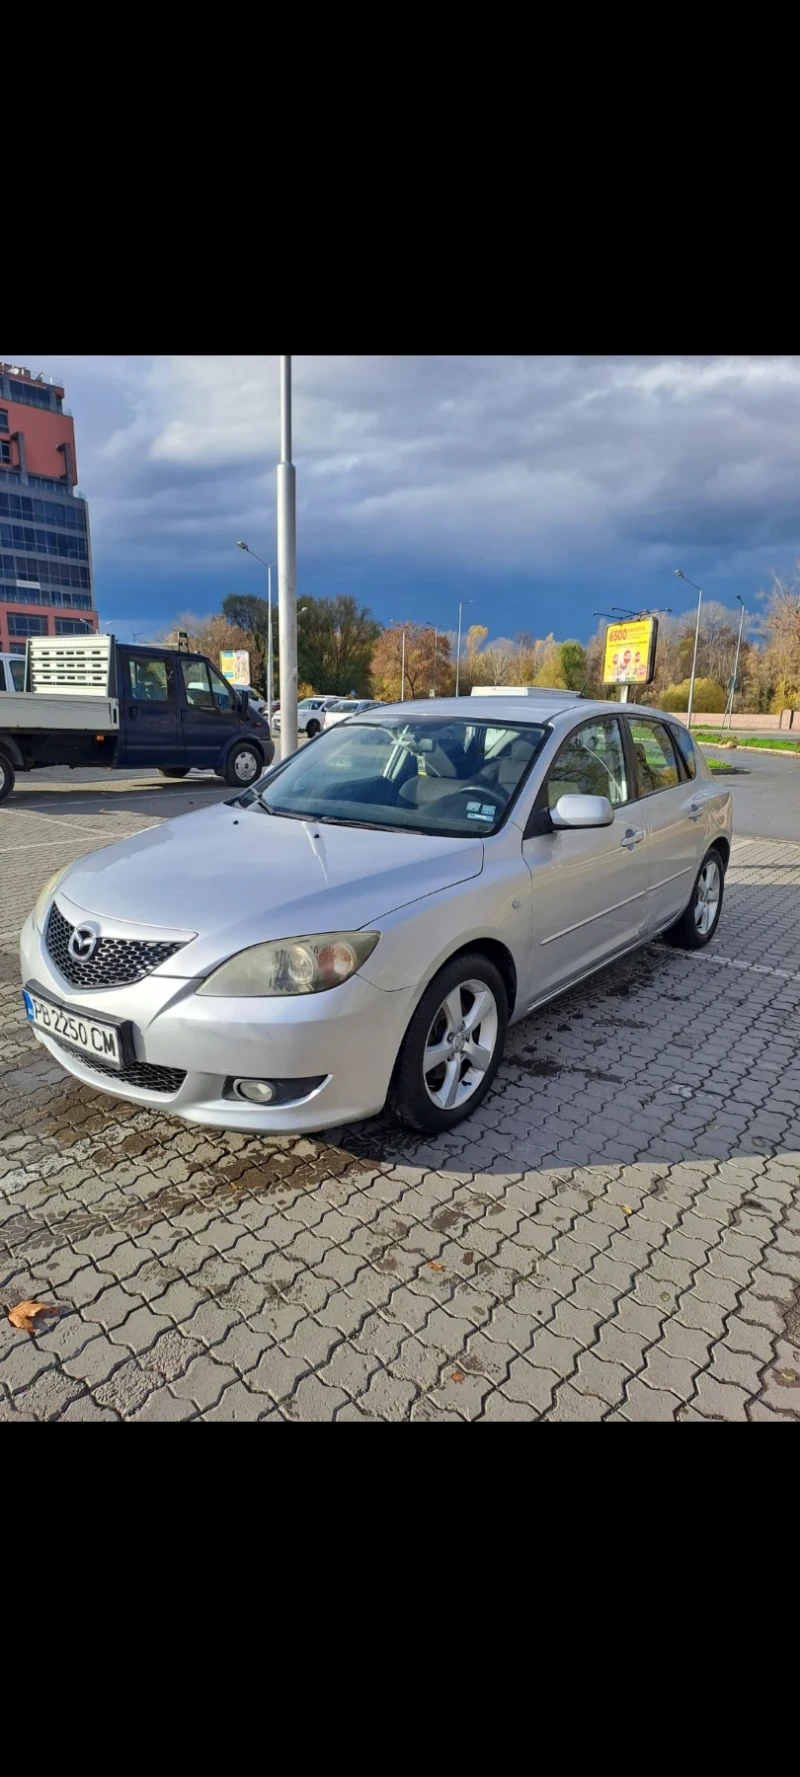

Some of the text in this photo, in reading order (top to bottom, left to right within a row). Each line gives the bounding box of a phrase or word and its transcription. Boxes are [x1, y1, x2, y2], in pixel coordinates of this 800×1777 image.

[609, 628, 627, 642] 6500
[32, 999, 116, 1057] PB 2250 CM
